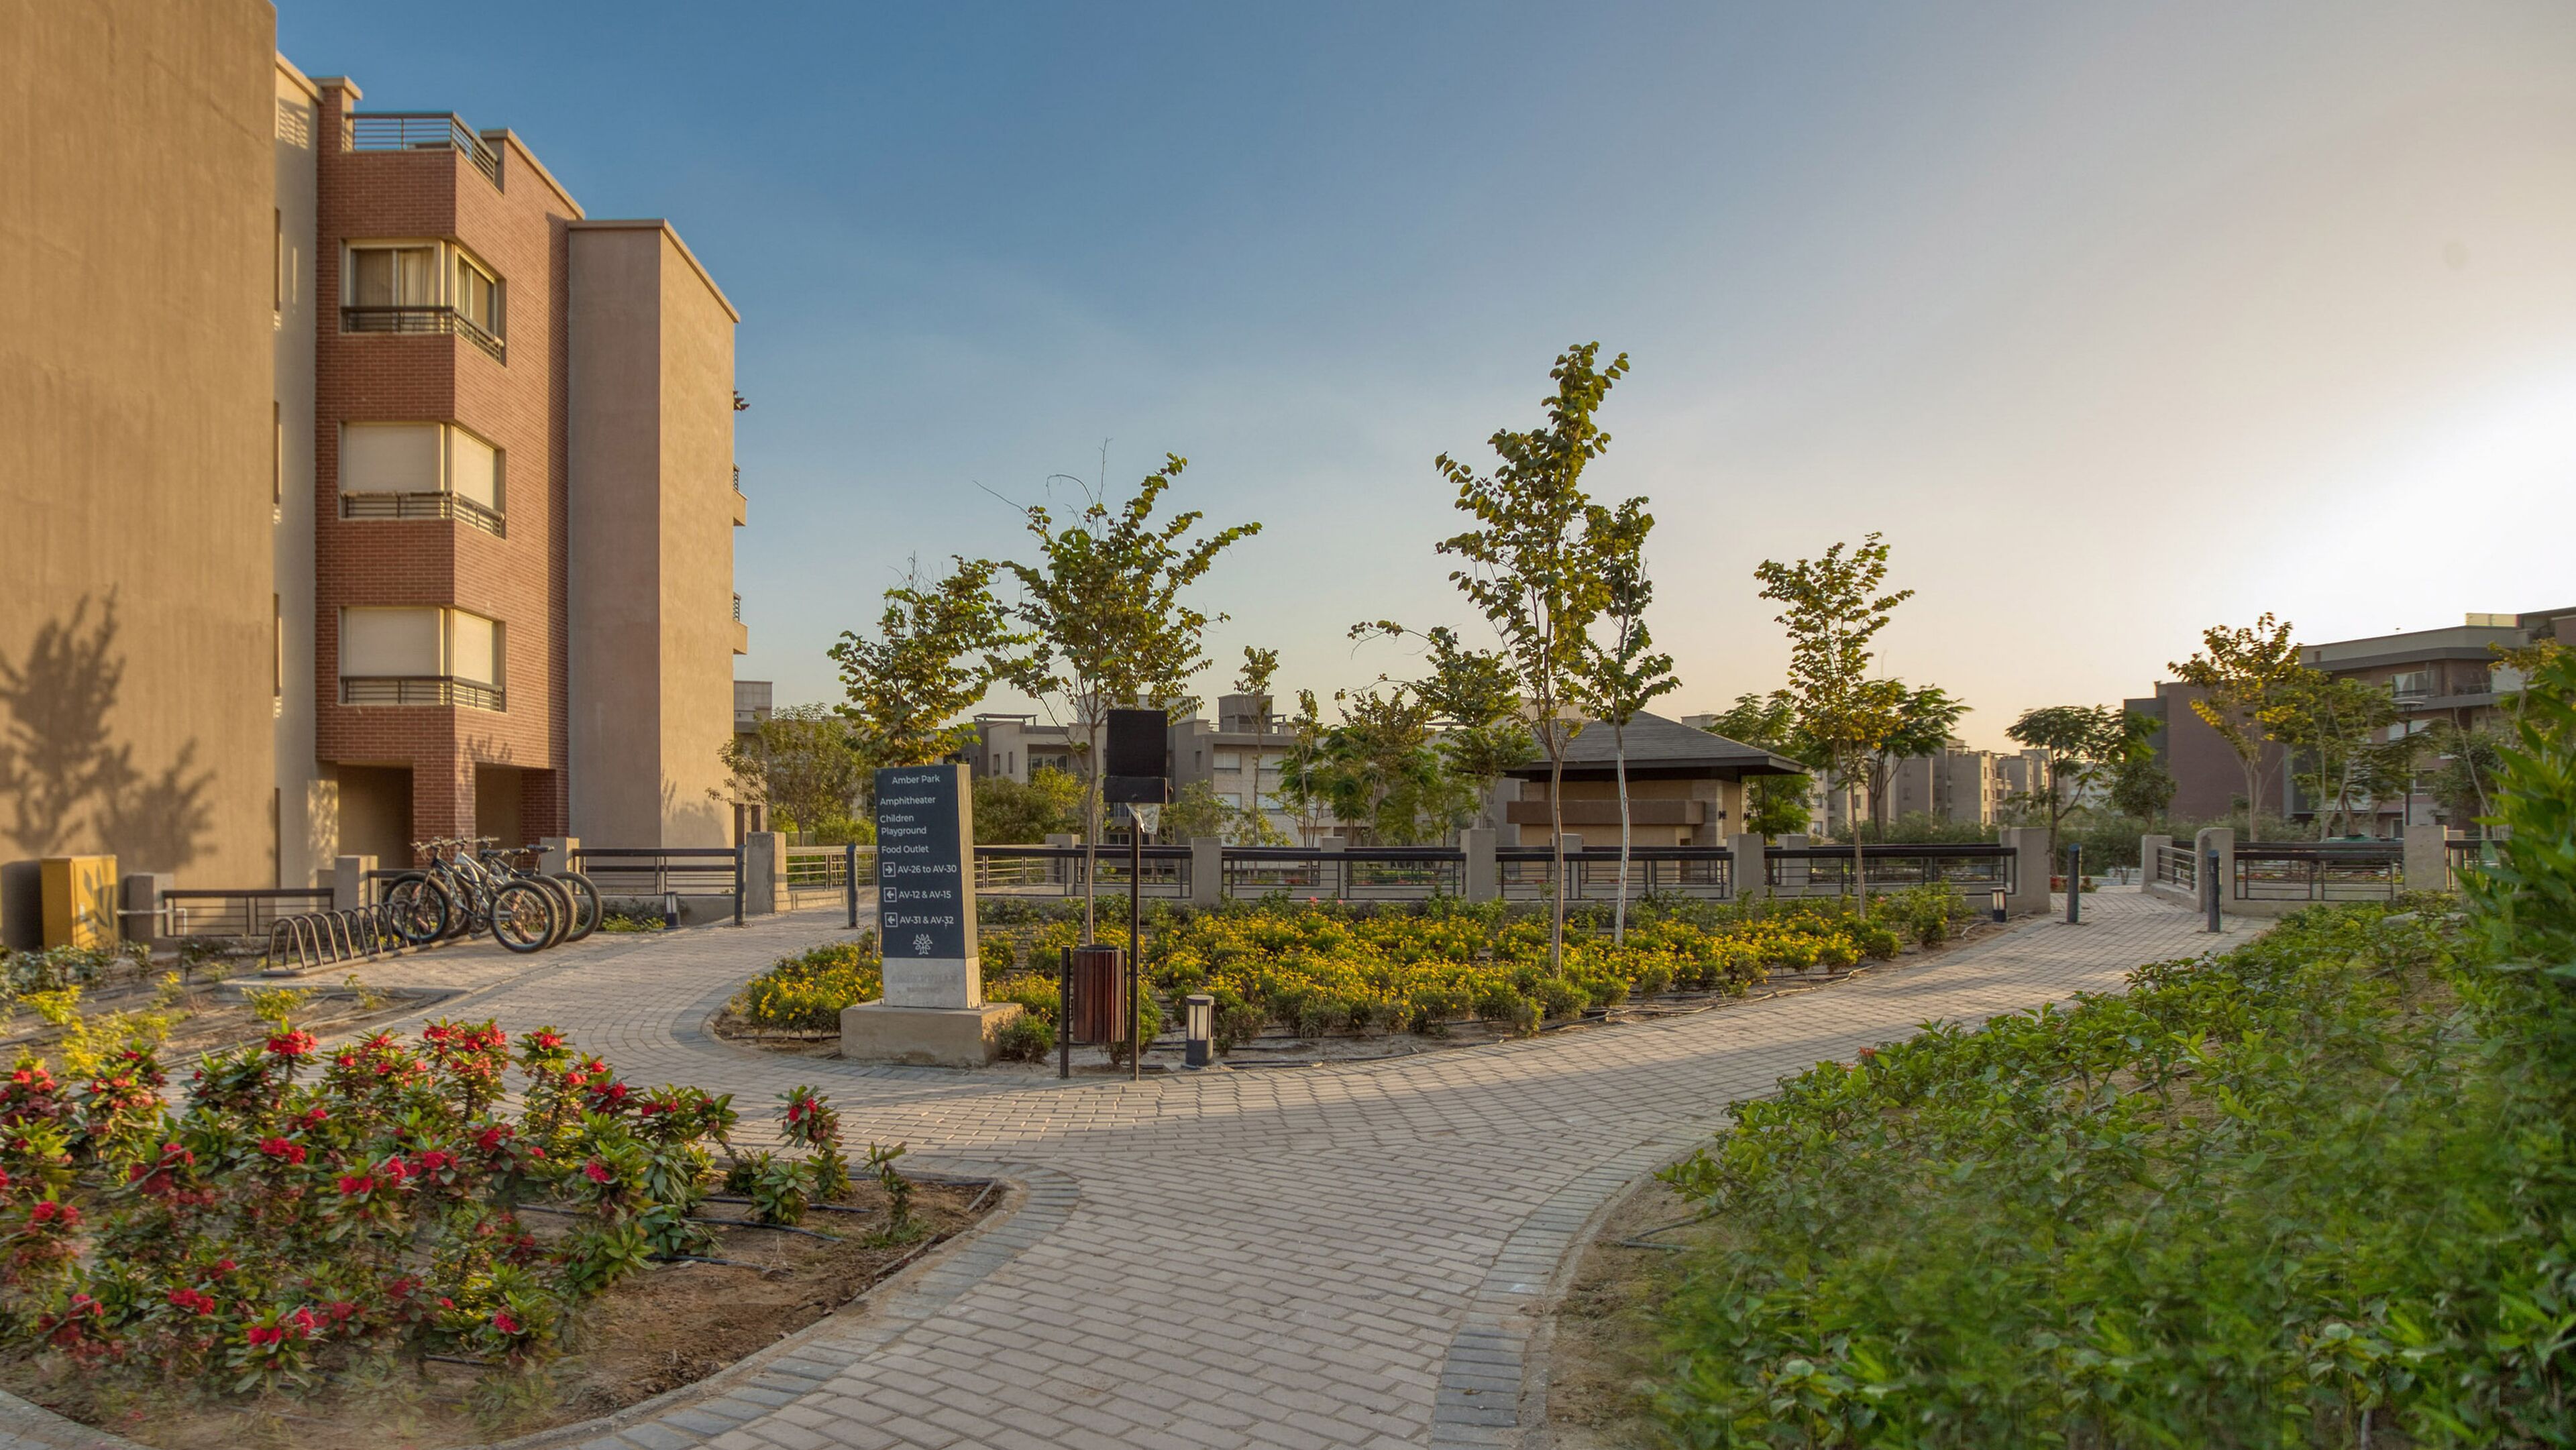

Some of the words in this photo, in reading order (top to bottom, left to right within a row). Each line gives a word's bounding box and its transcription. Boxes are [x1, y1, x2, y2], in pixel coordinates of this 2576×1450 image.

[892, 775, 919, 785] Amber
[922, 775, 941, 783] Park
[880, 796, 936, 806] Amphitheater
[879, 815, 914, 823] Children
[881, 826, 927, 837] Playground
[881, 846, 902, 854] Food
[903, 845, 929, 853] Outlet
[898, 865, 921, 873] AV-26
[932, 865, 957, 873] AV-30
[898, 891, 920, 899] AV-12
[922, 891, 928, 899] &
[929, 891, 951, 899] AV-15
[900, 916, 921, 924] AV-31
[923, 916, 929, 924] &
[930, 916, 954, 925] AV-32
